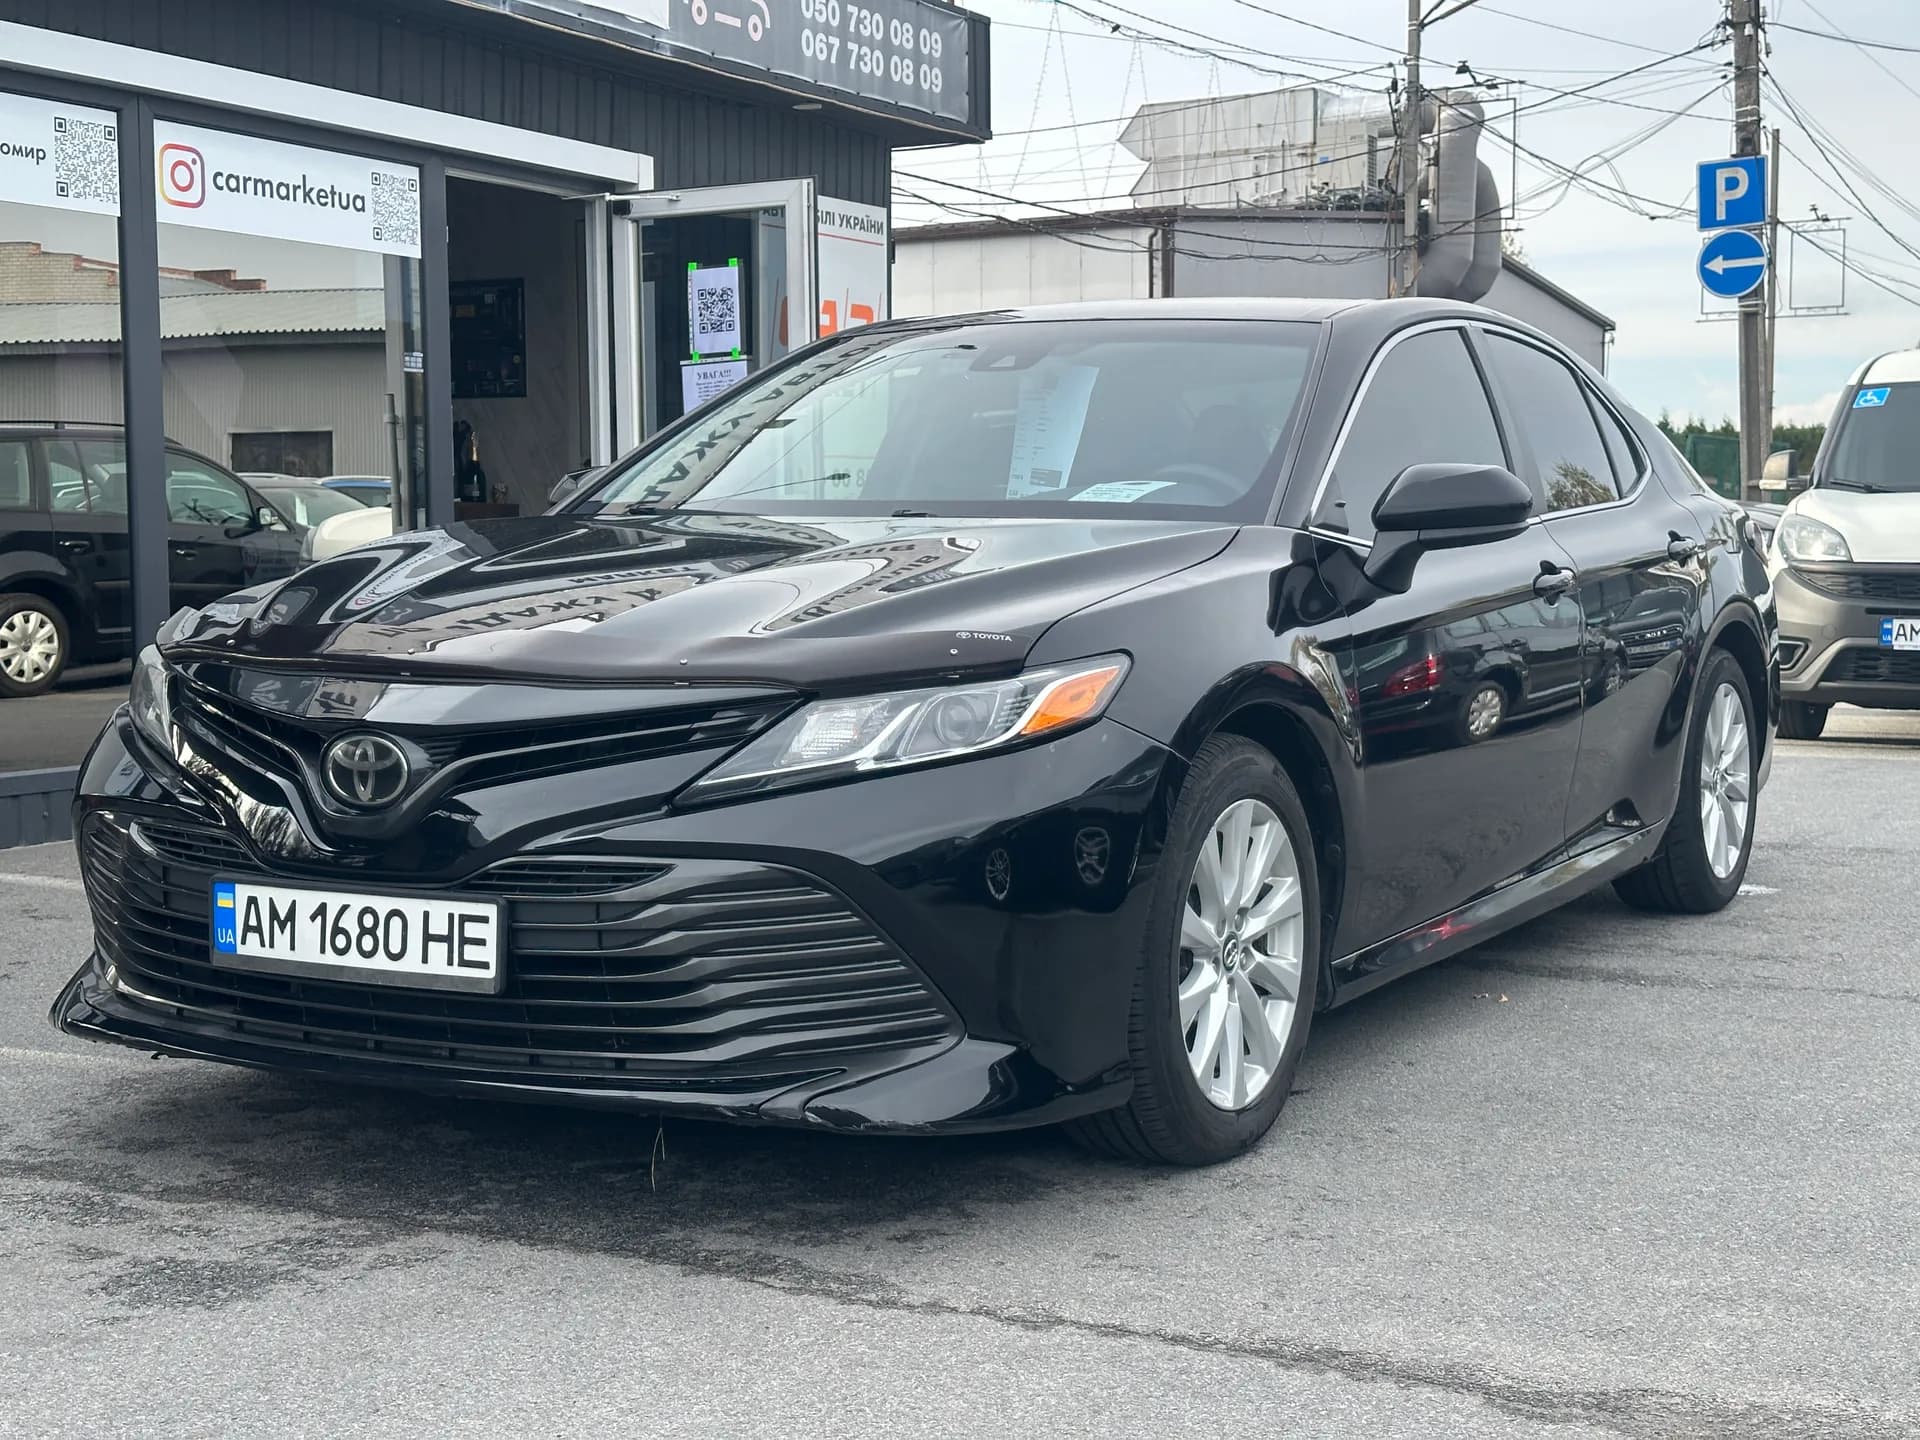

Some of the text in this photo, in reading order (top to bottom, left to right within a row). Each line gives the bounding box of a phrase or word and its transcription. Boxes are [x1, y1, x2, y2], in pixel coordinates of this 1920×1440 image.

[800, 0, 942, 58] 050 730 08 09
[801, 28, 942, 94] 067 730 08 09
[212, 170, 366, 213] carmarketua
[1716, 167, 1749, 221] P
[838, 212, 885, 236] УКРАЇНИ
[973, 632, 1013, 642] TOYOTA
[217, 895, 490, 970] UA AM 1680 HE
